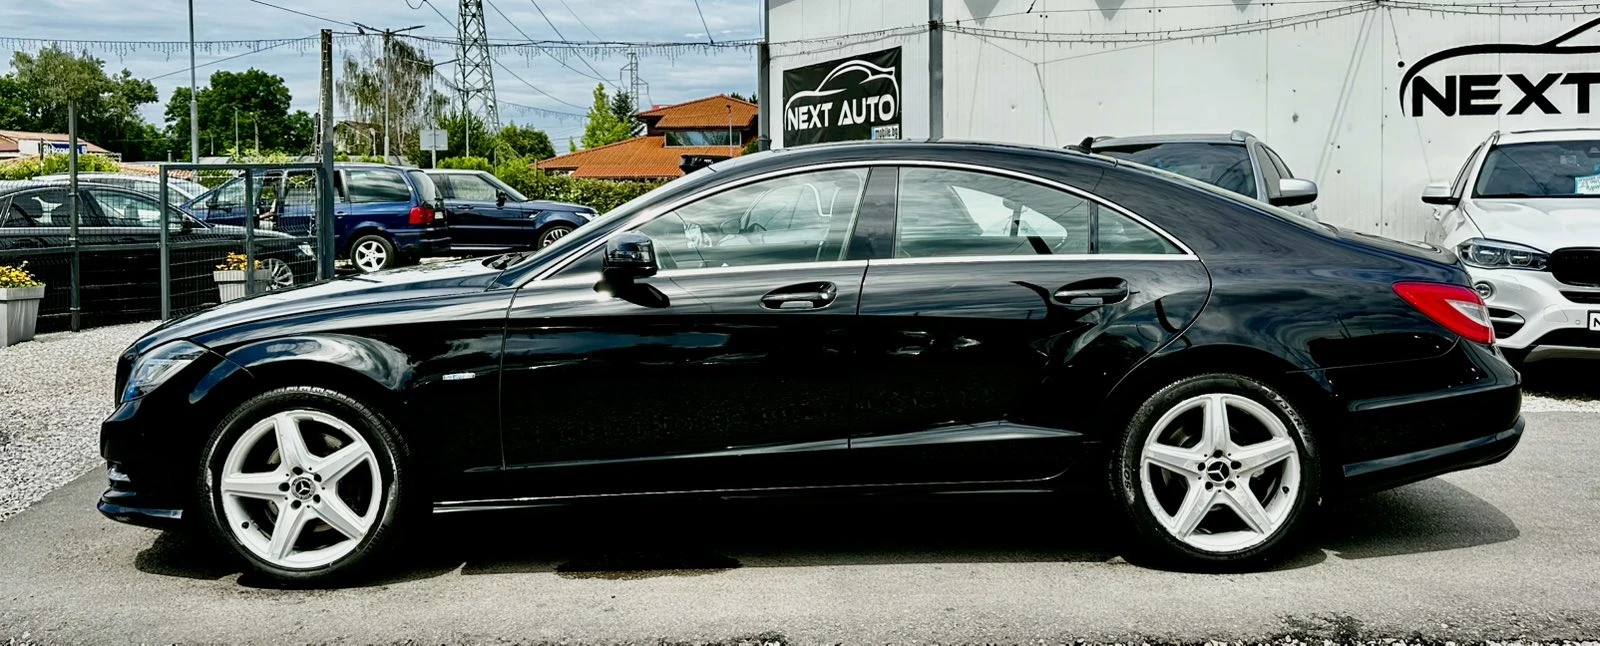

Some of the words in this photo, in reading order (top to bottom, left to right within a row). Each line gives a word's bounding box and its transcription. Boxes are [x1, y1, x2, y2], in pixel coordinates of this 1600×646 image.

[788, 102, 833, 131] NEXT
[837, 94, 895, 126] AUTO
[1412, 73, 1600, 117] NEXT
